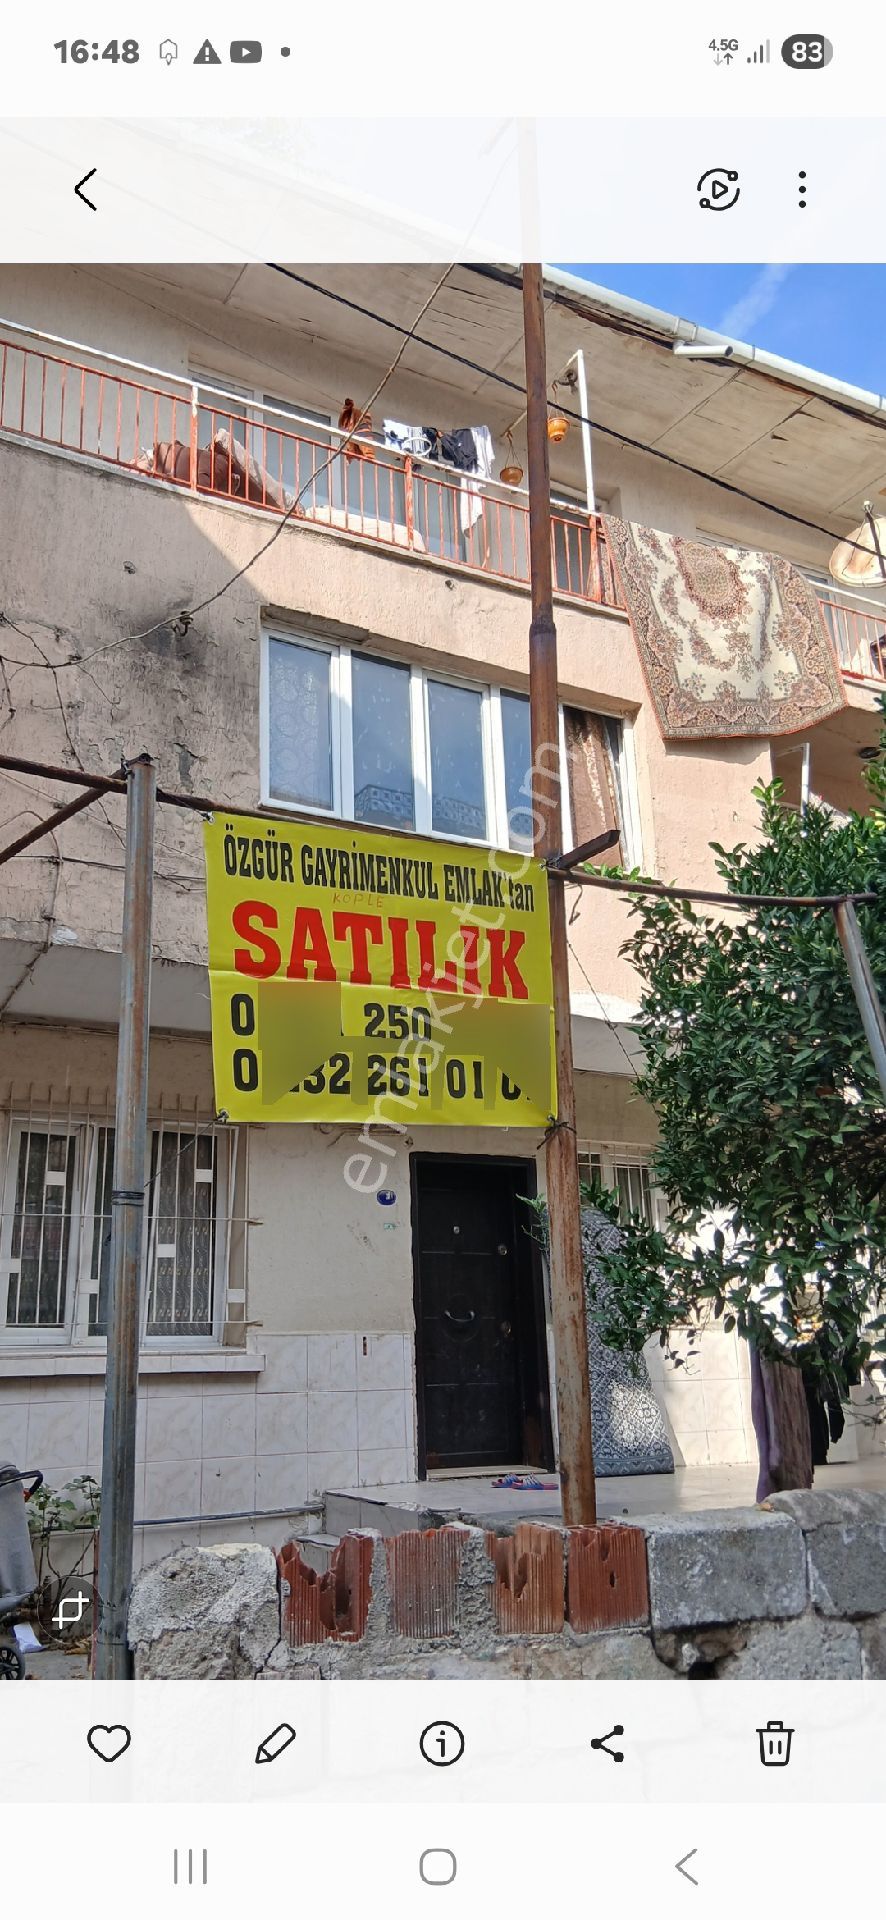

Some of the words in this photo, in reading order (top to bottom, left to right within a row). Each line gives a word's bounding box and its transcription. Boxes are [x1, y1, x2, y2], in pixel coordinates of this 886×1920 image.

[54, 39, 140, 64] 16:48
[708, 38, 739, 52] 4.5G
[791, 41, 823, 63] 83
[224, 823, 295, 882] ÖZGÜR
[301, 840, 438, 900] GAYRİMENKUL
[443, 864, 535, 913] EMLAK'tan
[232, 899, 529, 1000] SATILIK
[230, 993, 256, 1036] 0
[363, 1002, 432, 1042] 250
[232, 1048, 259, 1092] 0
[367, 1054, 429, 1097] 261
